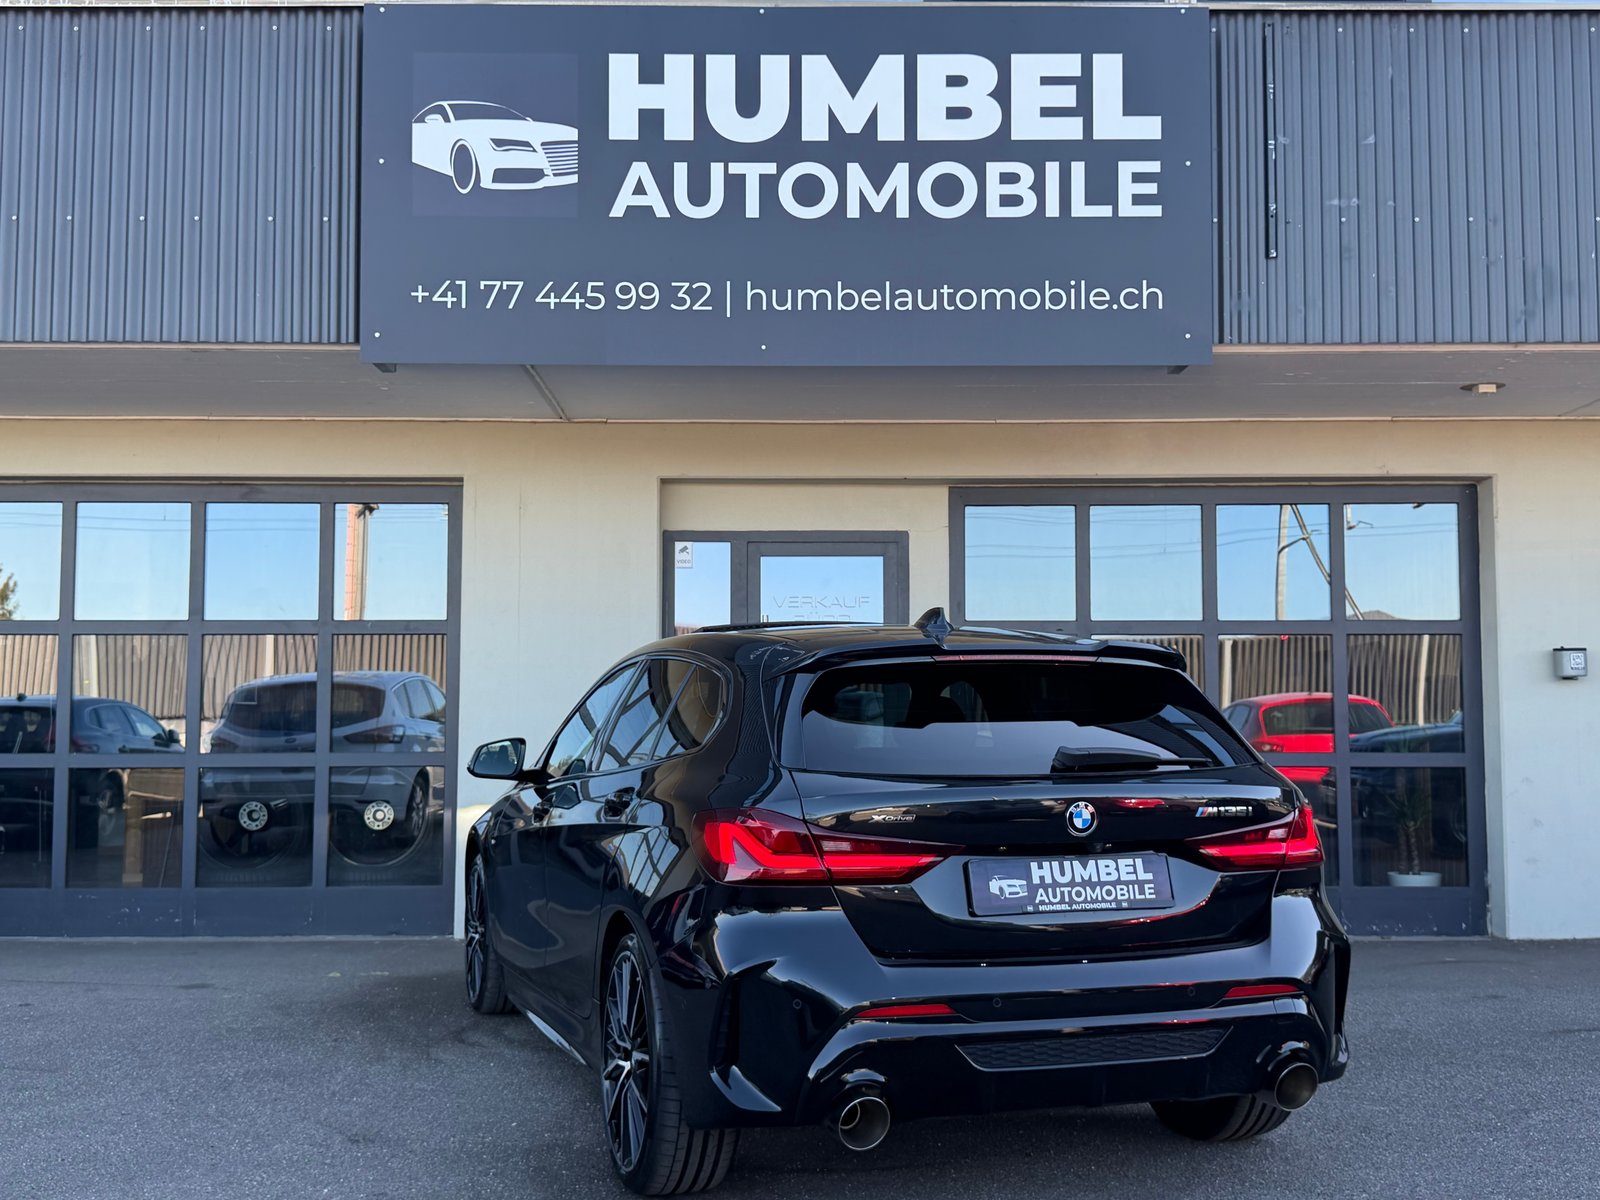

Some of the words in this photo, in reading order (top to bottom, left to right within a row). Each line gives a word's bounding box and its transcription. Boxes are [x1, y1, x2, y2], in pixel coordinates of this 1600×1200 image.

[608, 52, 1162, 143] HUMBEL
[608, 160, 1163, 220] AUTOMOBILE
[410, 280, 467, 309] +41
[479, 280, 524, 310] 77
[534, 281, 606, 311] 445
[614, 281, 660, 311] 99
[670, 281, 713, 311] 32
[746, 279, 1163, 311] humbelautomobile.ch
[773, 596, 870, 608] VERKAUF
[1030, 858, 1154, 885] HUMBEL
[1035, 884, 1157, 904] AUTOMOBILE
[1038, 903, 1071, 912] HUMBEL
[1072, 902, 1117, 911] AUTOMOBILE
